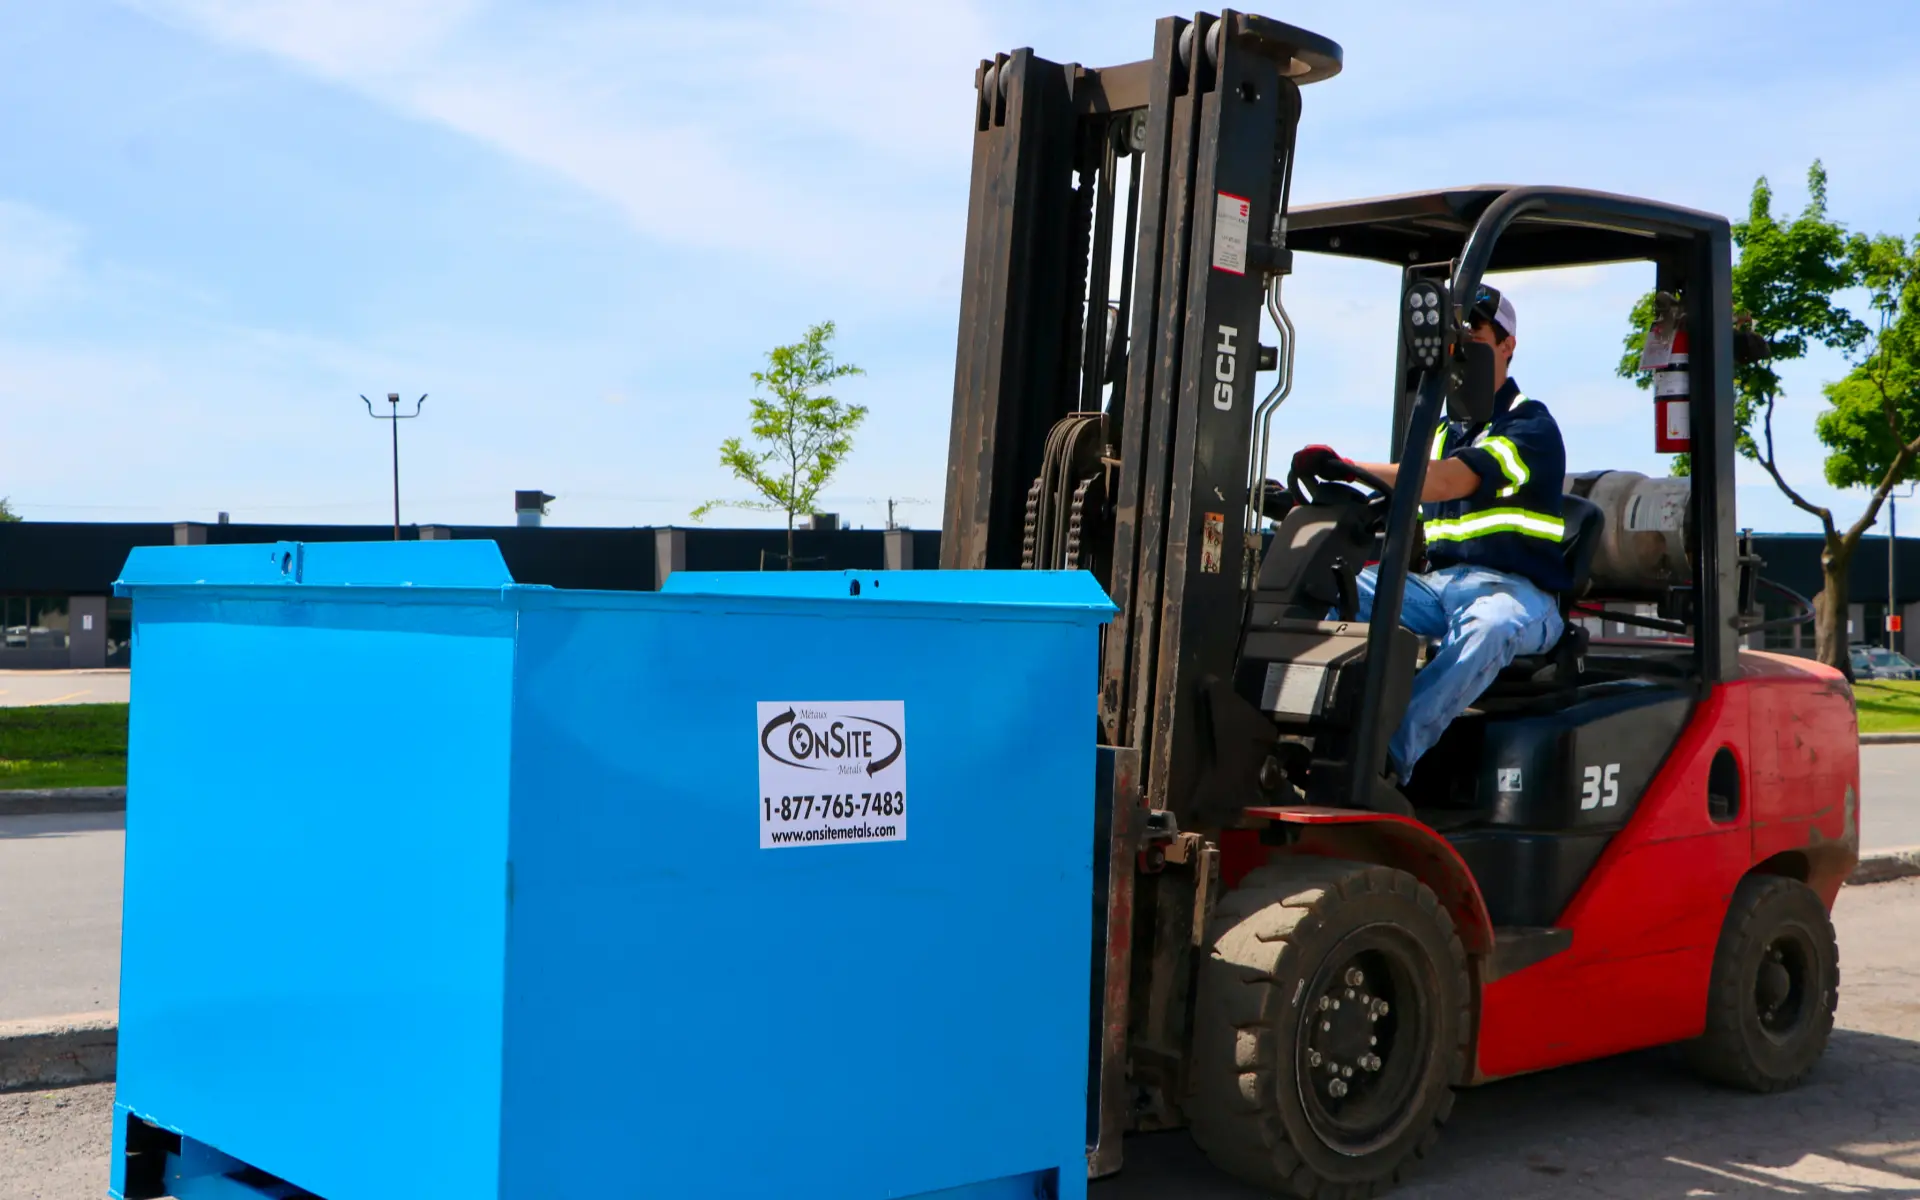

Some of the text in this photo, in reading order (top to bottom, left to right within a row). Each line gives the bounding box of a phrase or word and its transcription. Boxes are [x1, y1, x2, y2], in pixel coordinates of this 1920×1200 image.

[1213, 325, 1238, 411] GCH
[1580, 763, 1621, 810] 35
[764, 791, 904, 822] 1-877-765-7483
[771, 823, 896, 843] www.onsitemetals.com
